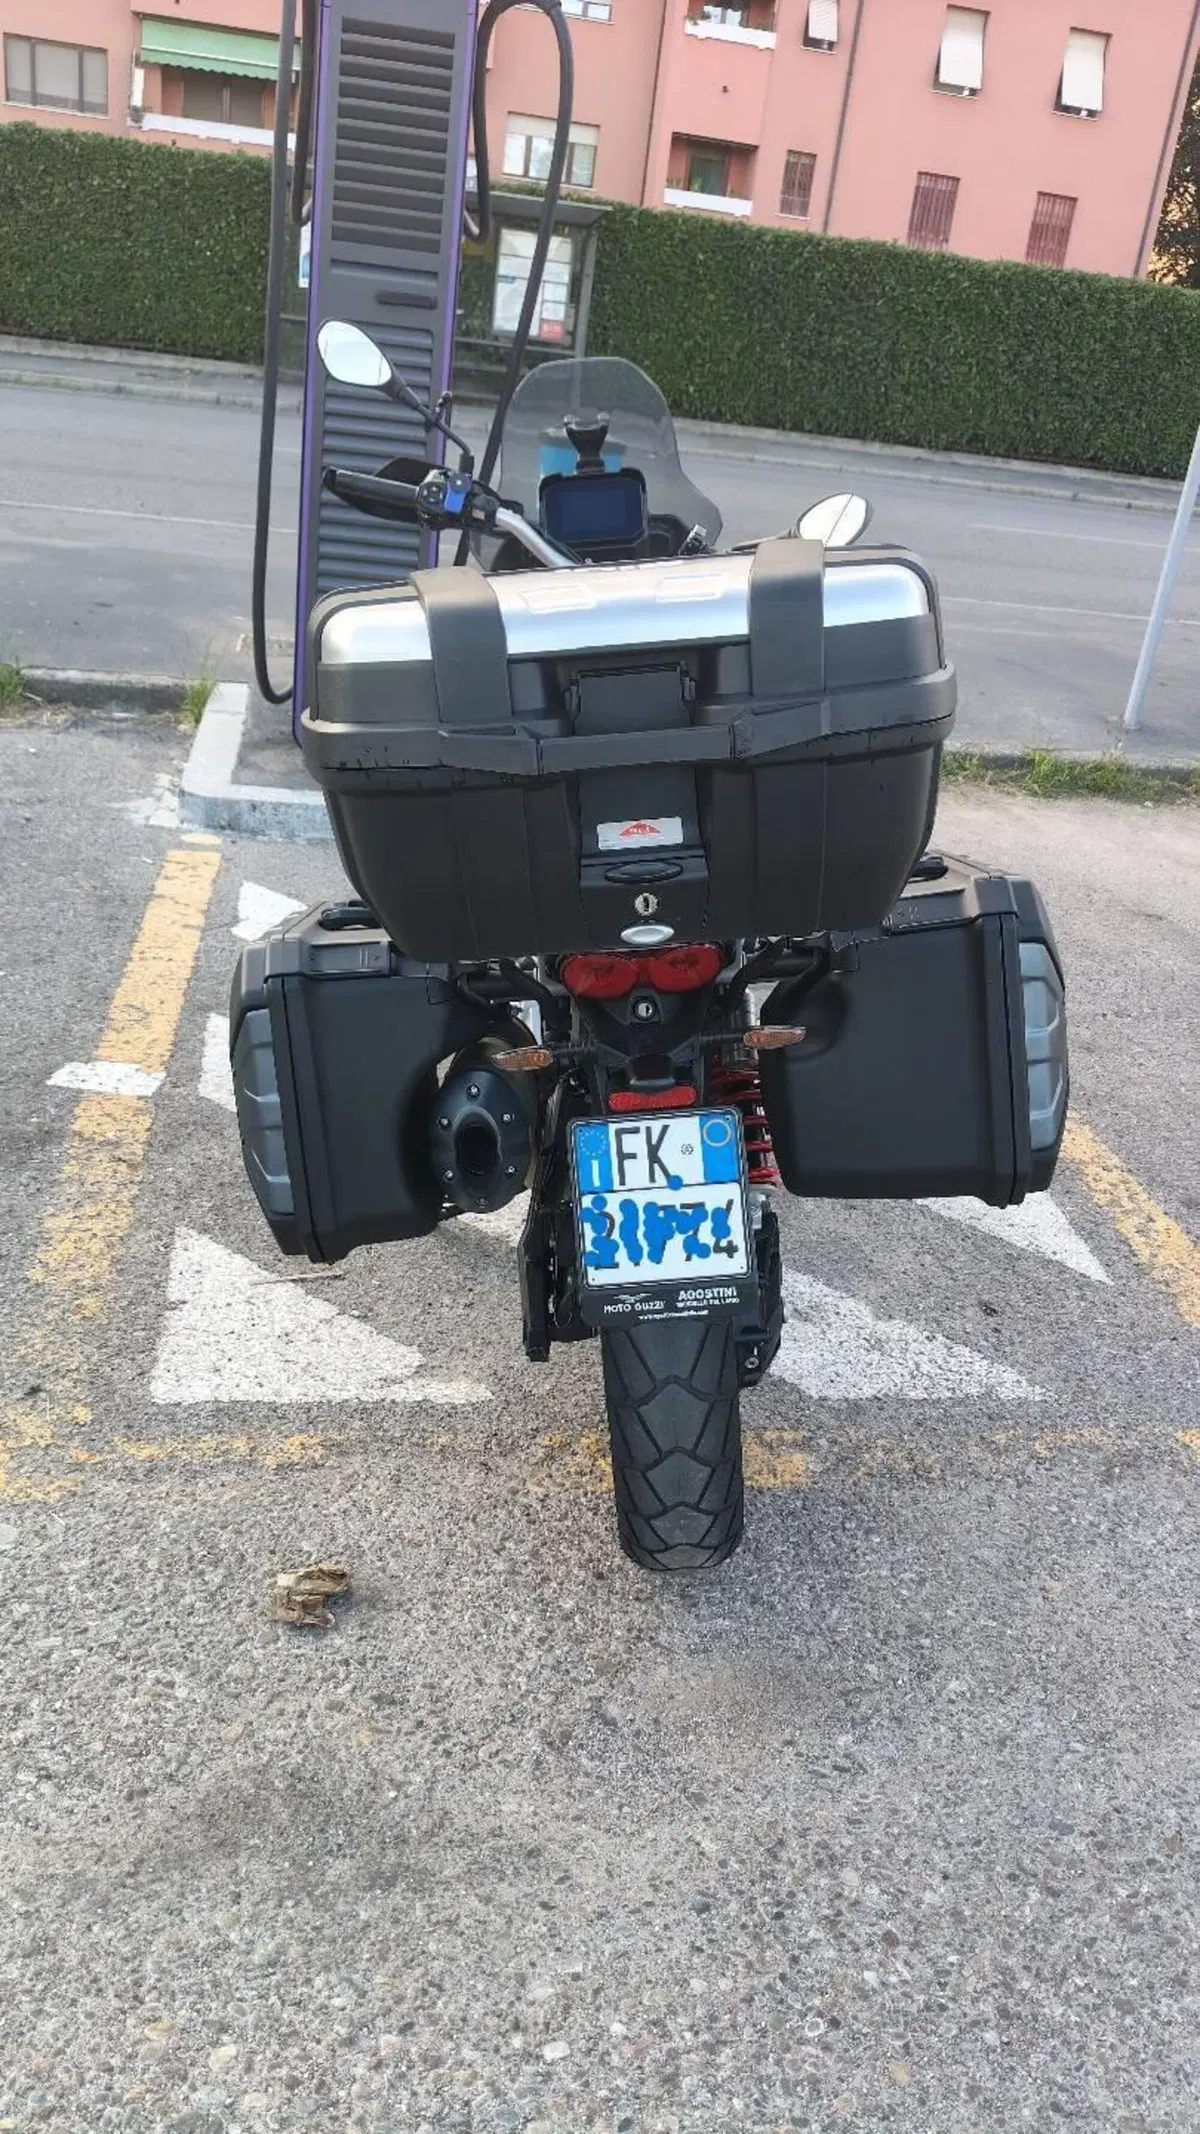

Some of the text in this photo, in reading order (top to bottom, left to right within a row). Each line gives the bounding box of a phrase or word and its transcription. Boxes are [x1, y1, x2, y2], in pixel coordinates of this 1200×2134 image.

[614, 1124, 673, 1186] FK
[678, 1286, 737, 1300] AGOSTINI
[604, 1300, 664, 1314] MOTO GUZZI
